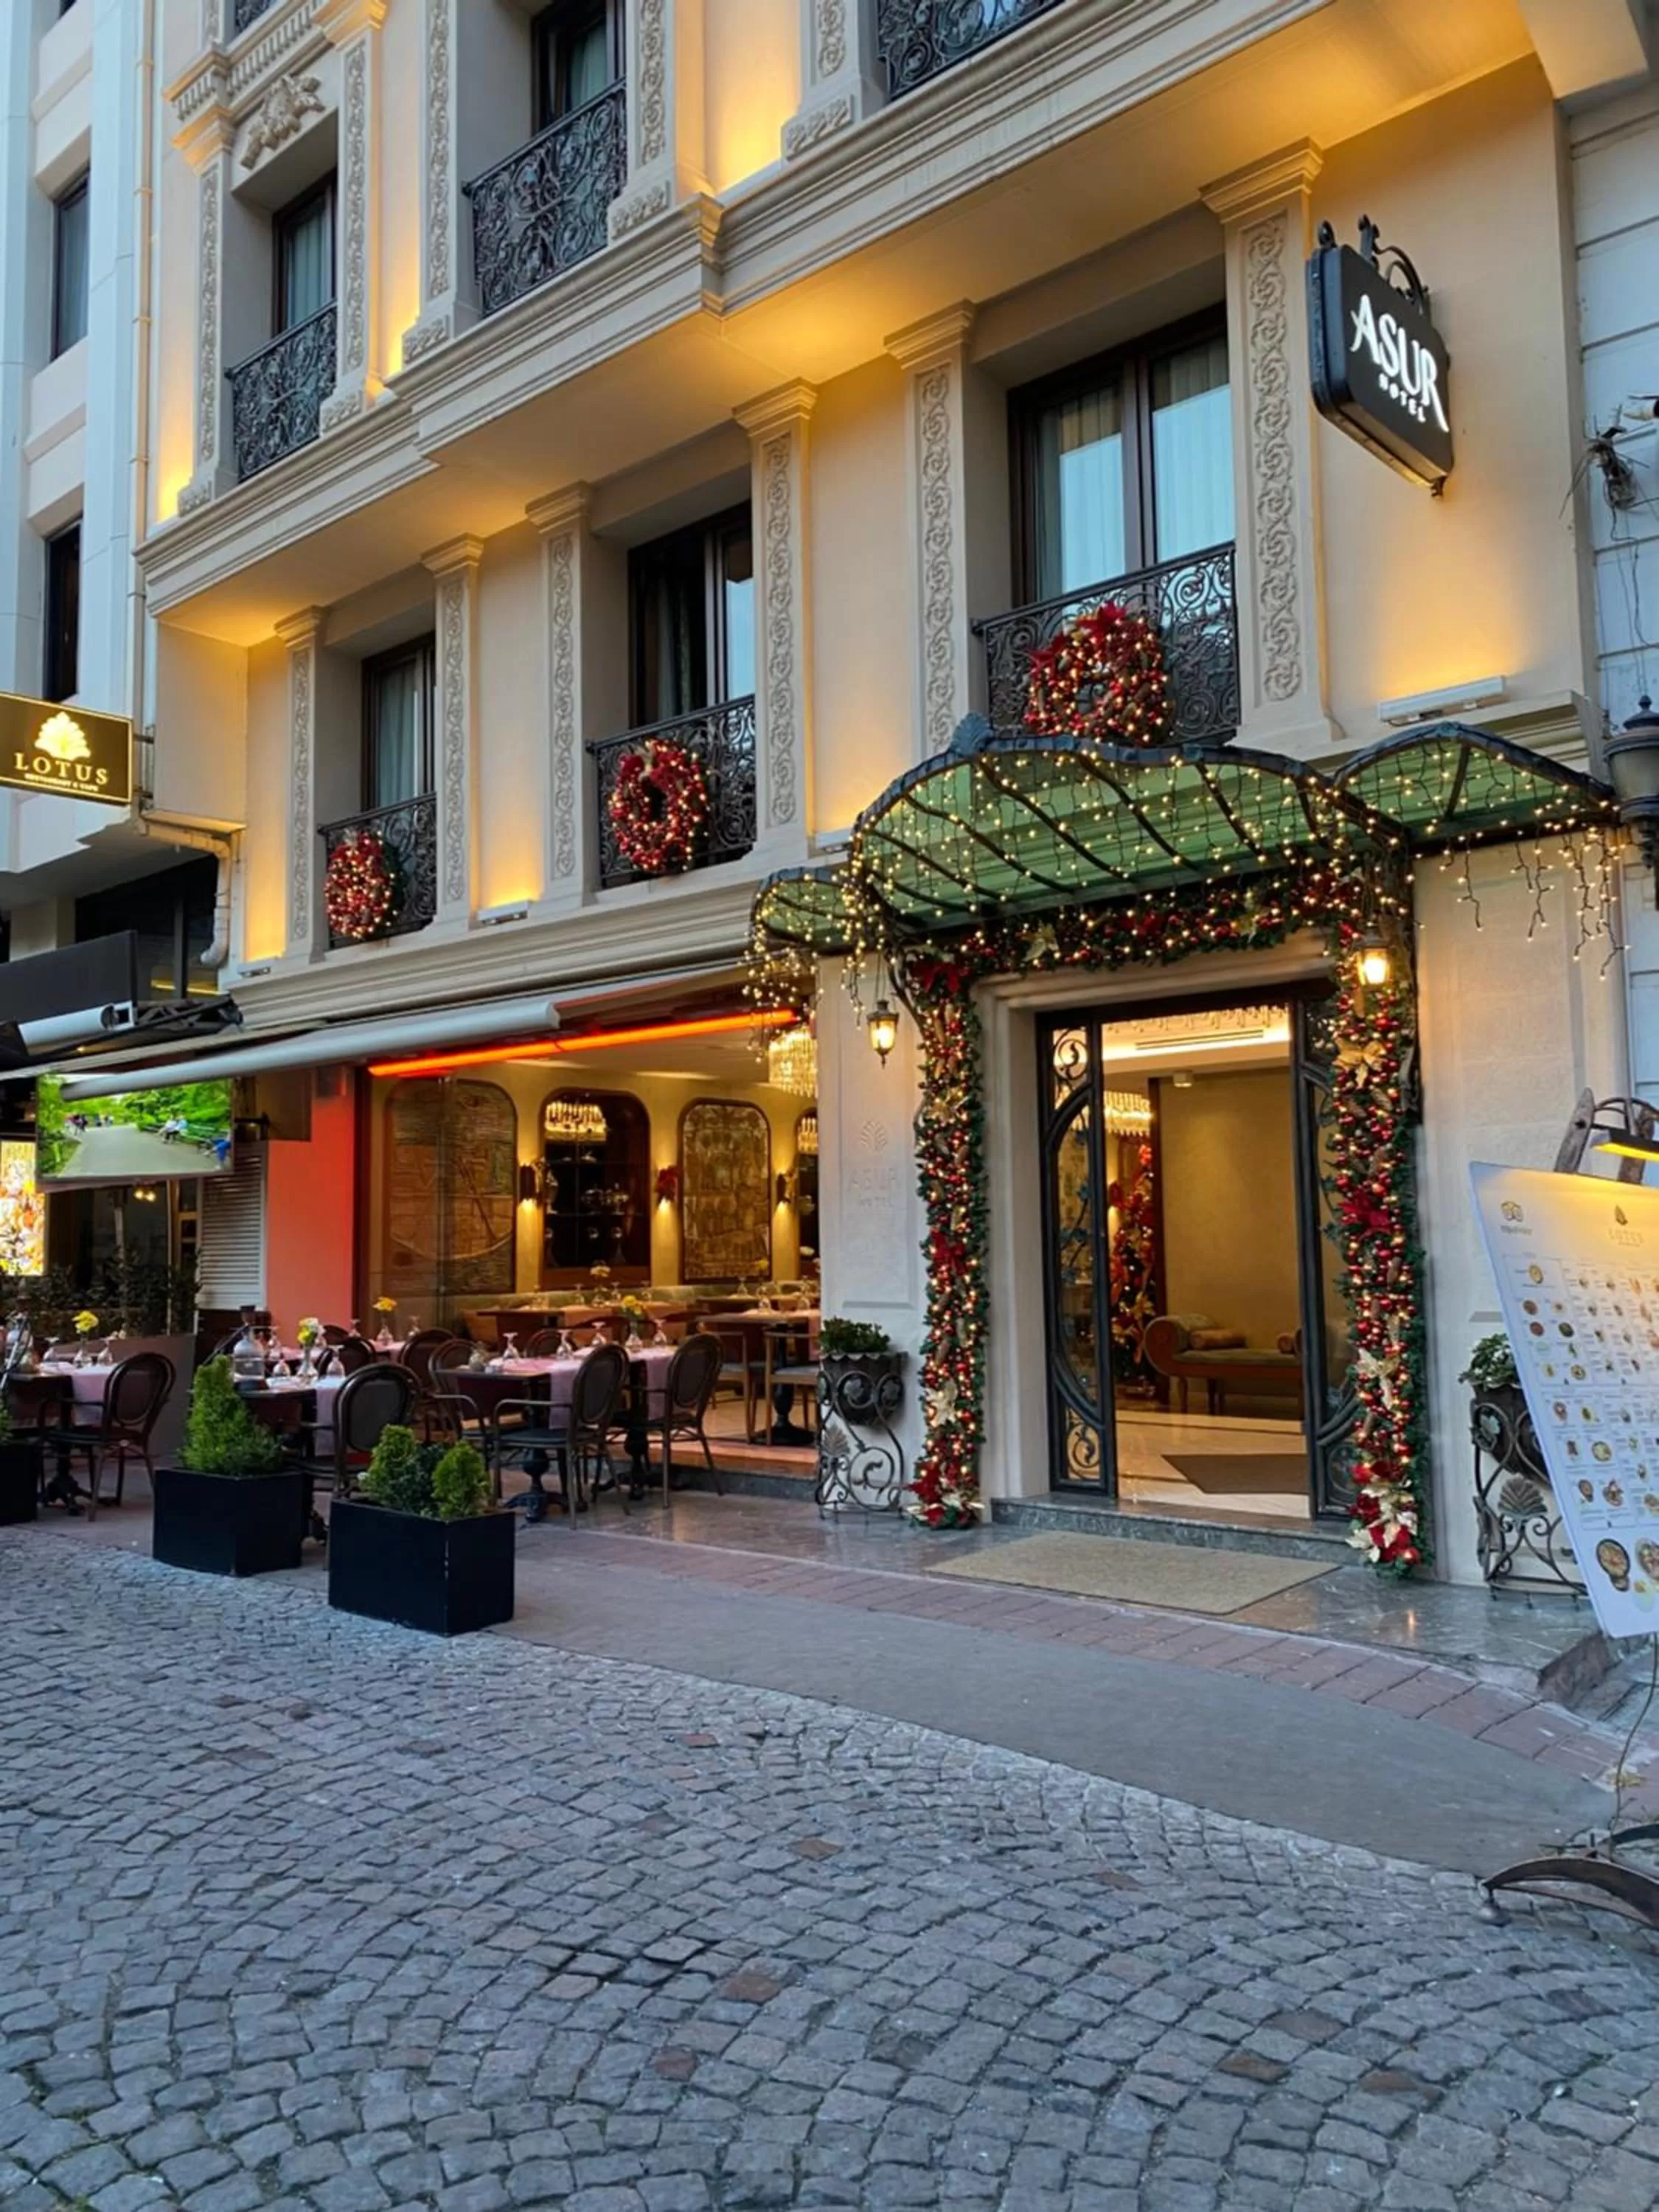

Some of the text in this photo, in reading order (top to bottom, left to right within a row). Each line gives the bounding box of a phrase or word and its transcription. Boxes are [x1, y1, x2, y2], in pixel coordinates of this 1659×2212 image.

[1350, 294, 1450, 434] ASUR
[1378, 372, 1426, 423] HOTEL
[15, 752, 108, 785] LOTUS
